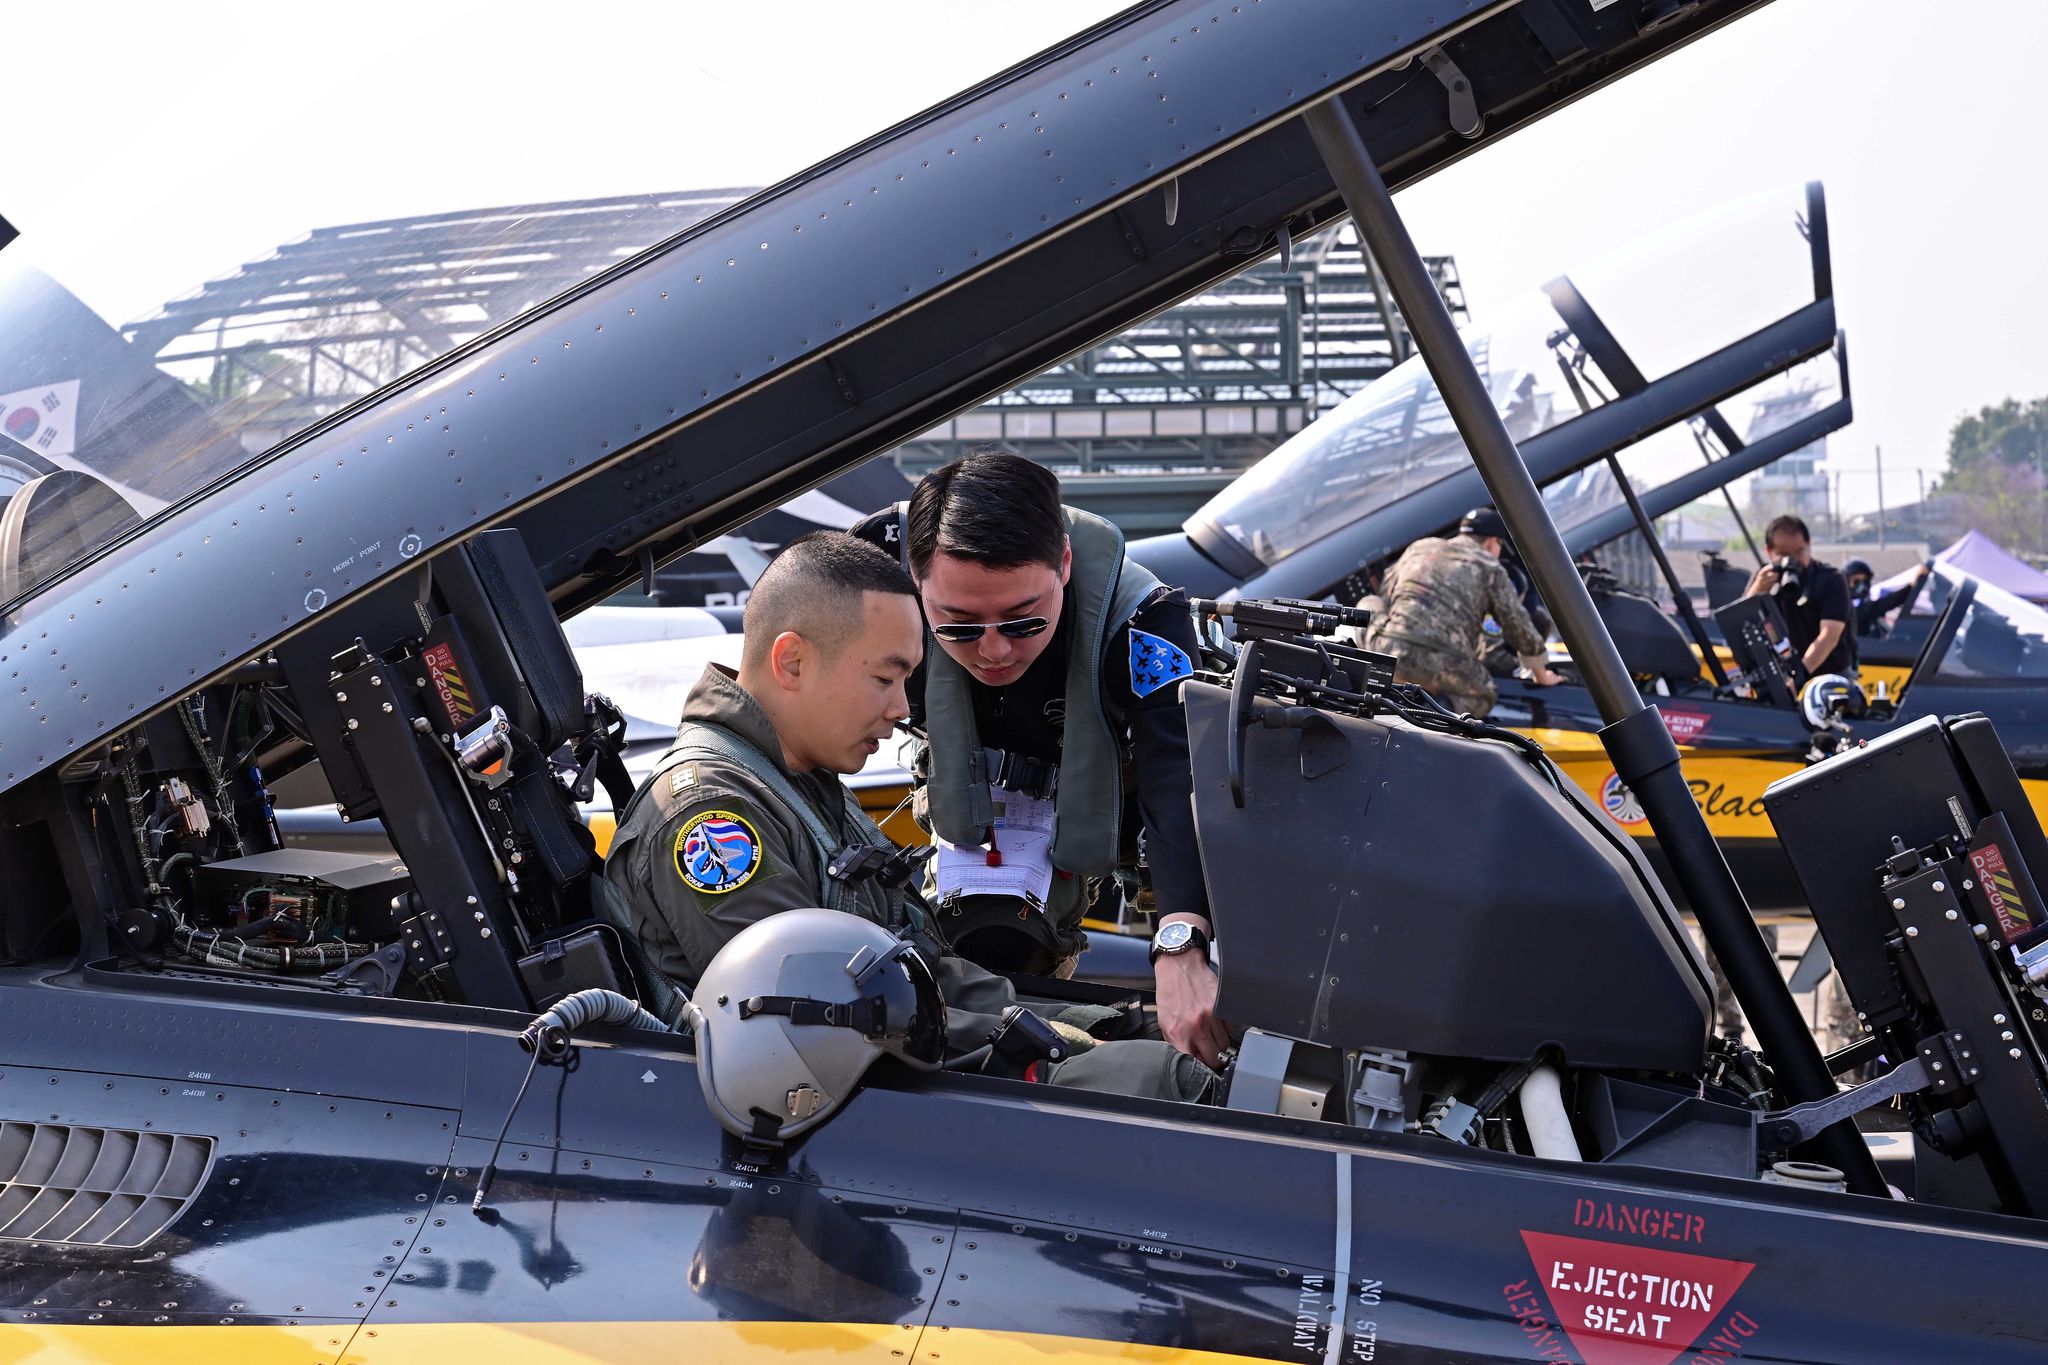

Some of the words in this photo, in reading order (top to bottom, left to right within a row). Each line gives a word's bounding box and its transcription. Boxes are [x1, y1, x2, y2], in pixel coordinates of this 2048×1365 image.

[332, 556, 354, 573] HOIST
[359, 541, 381, 558] POINT
[437, 653, 448, 661] NOT
[438, 658, 452, 667] PULL
[425, 654, 462, 726] DANGER
[677, 813, 714, 851] BROTHERHOOD
[716, 813, 738, 823] SPIRIT
[1986, 849, 1995, 857] DO
[1987, 855, 1999, 863] NOT
[1988, 860, 2003, 869] PULL
[1973, 856, 2015, 932] DANGER
[2007, 927, 2032, 938] HANDLE
[735, 1163, 759, 1173] 2404
[729, 1180, 753, 1189] 2404
[1574, 1198, 1706, 1243] DANGER
[1143, 1229, 1168, 1239] 2402
[1138, 1245, 1163, 1255] 2402
[1360, 1279, 1383, 1306] NO
[1551, 1261, 1713, 1312] EJECTION
[1293, 1275, 1324, 1352] WALKWAY
[1584, 1304, 1671, 1340] SEAT
[1353, 1320, 1377, 1362] STEP
